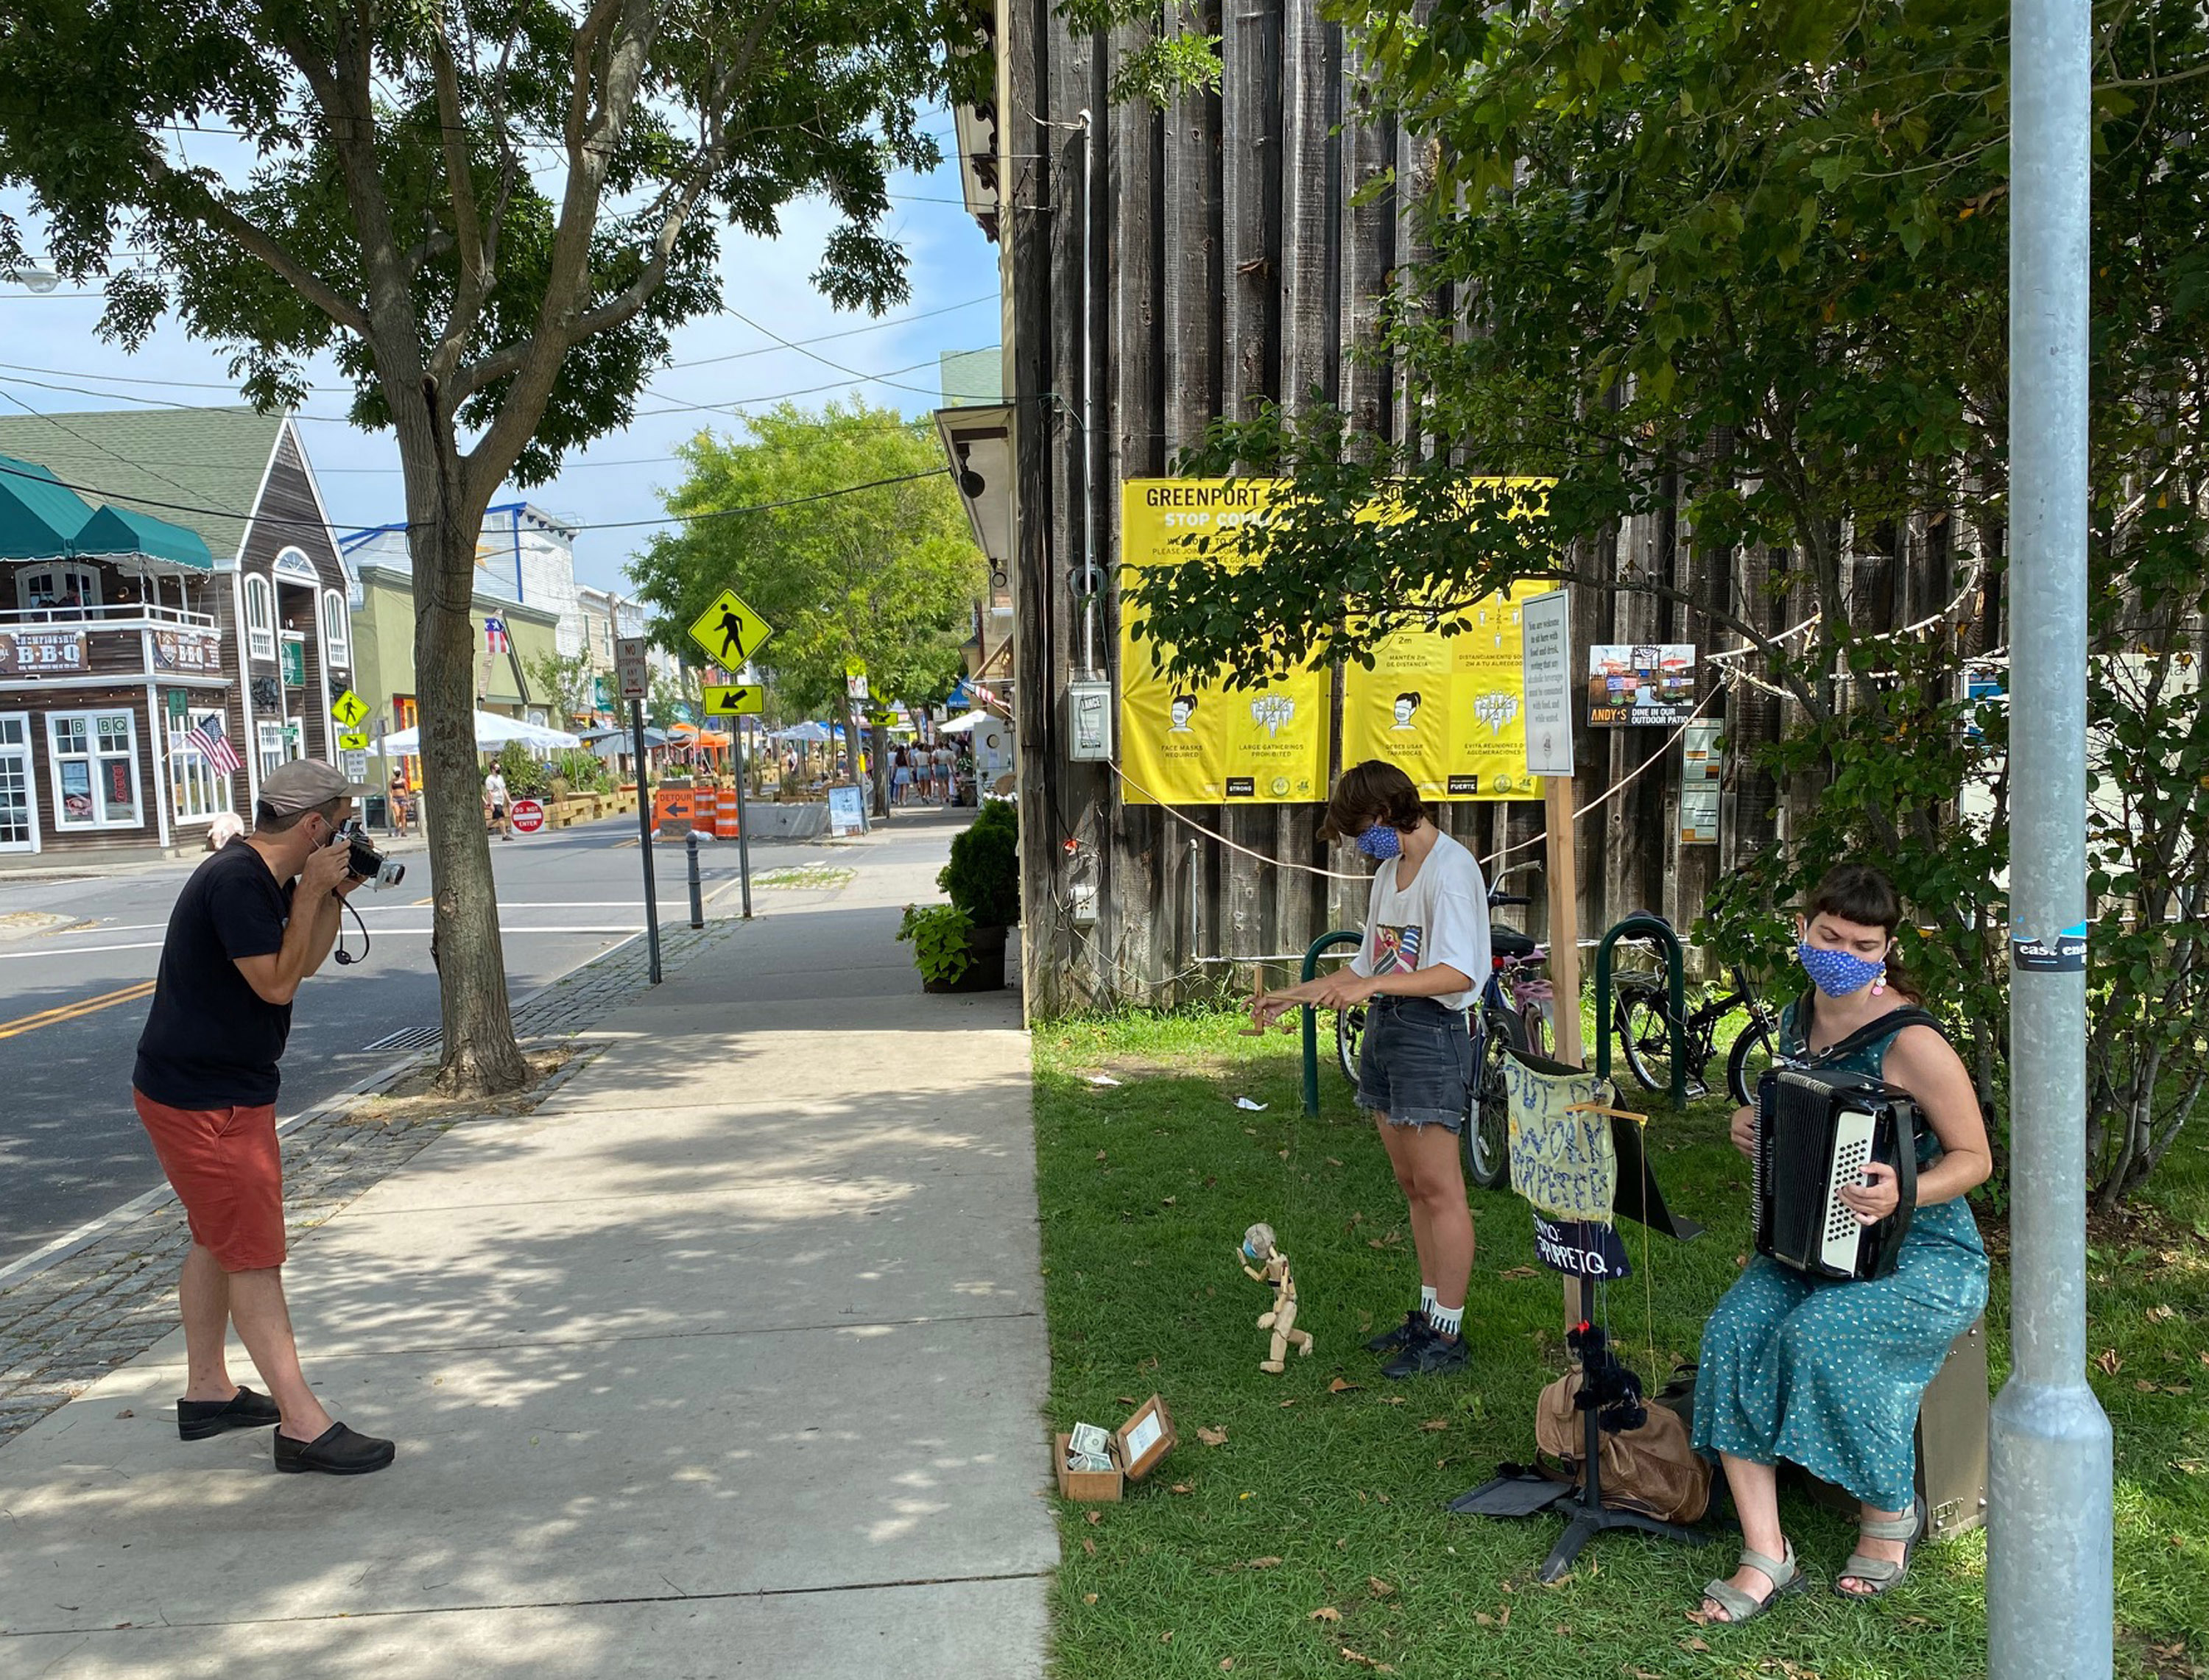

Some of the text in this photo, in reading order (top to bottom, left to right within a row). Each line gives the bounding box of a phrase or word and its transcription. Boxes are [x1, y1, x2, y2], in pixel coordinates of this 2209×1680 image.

[1146, 488, 1260, 506] GREENPORT
[1165, 512, 1210, 527] STOP
[625, 643, 636, 655] NO
[1591, 709, 1627, 721] ANDY'S
[1632, 708, 1649, 716] DINE
[1660, 707, 1676, 716] OUR
[1631, 716, 1688, 724] OUTDOOR PATIO
[660, 794, 693, 802] DETOUR
[2019, 945, 2058, 956] east
